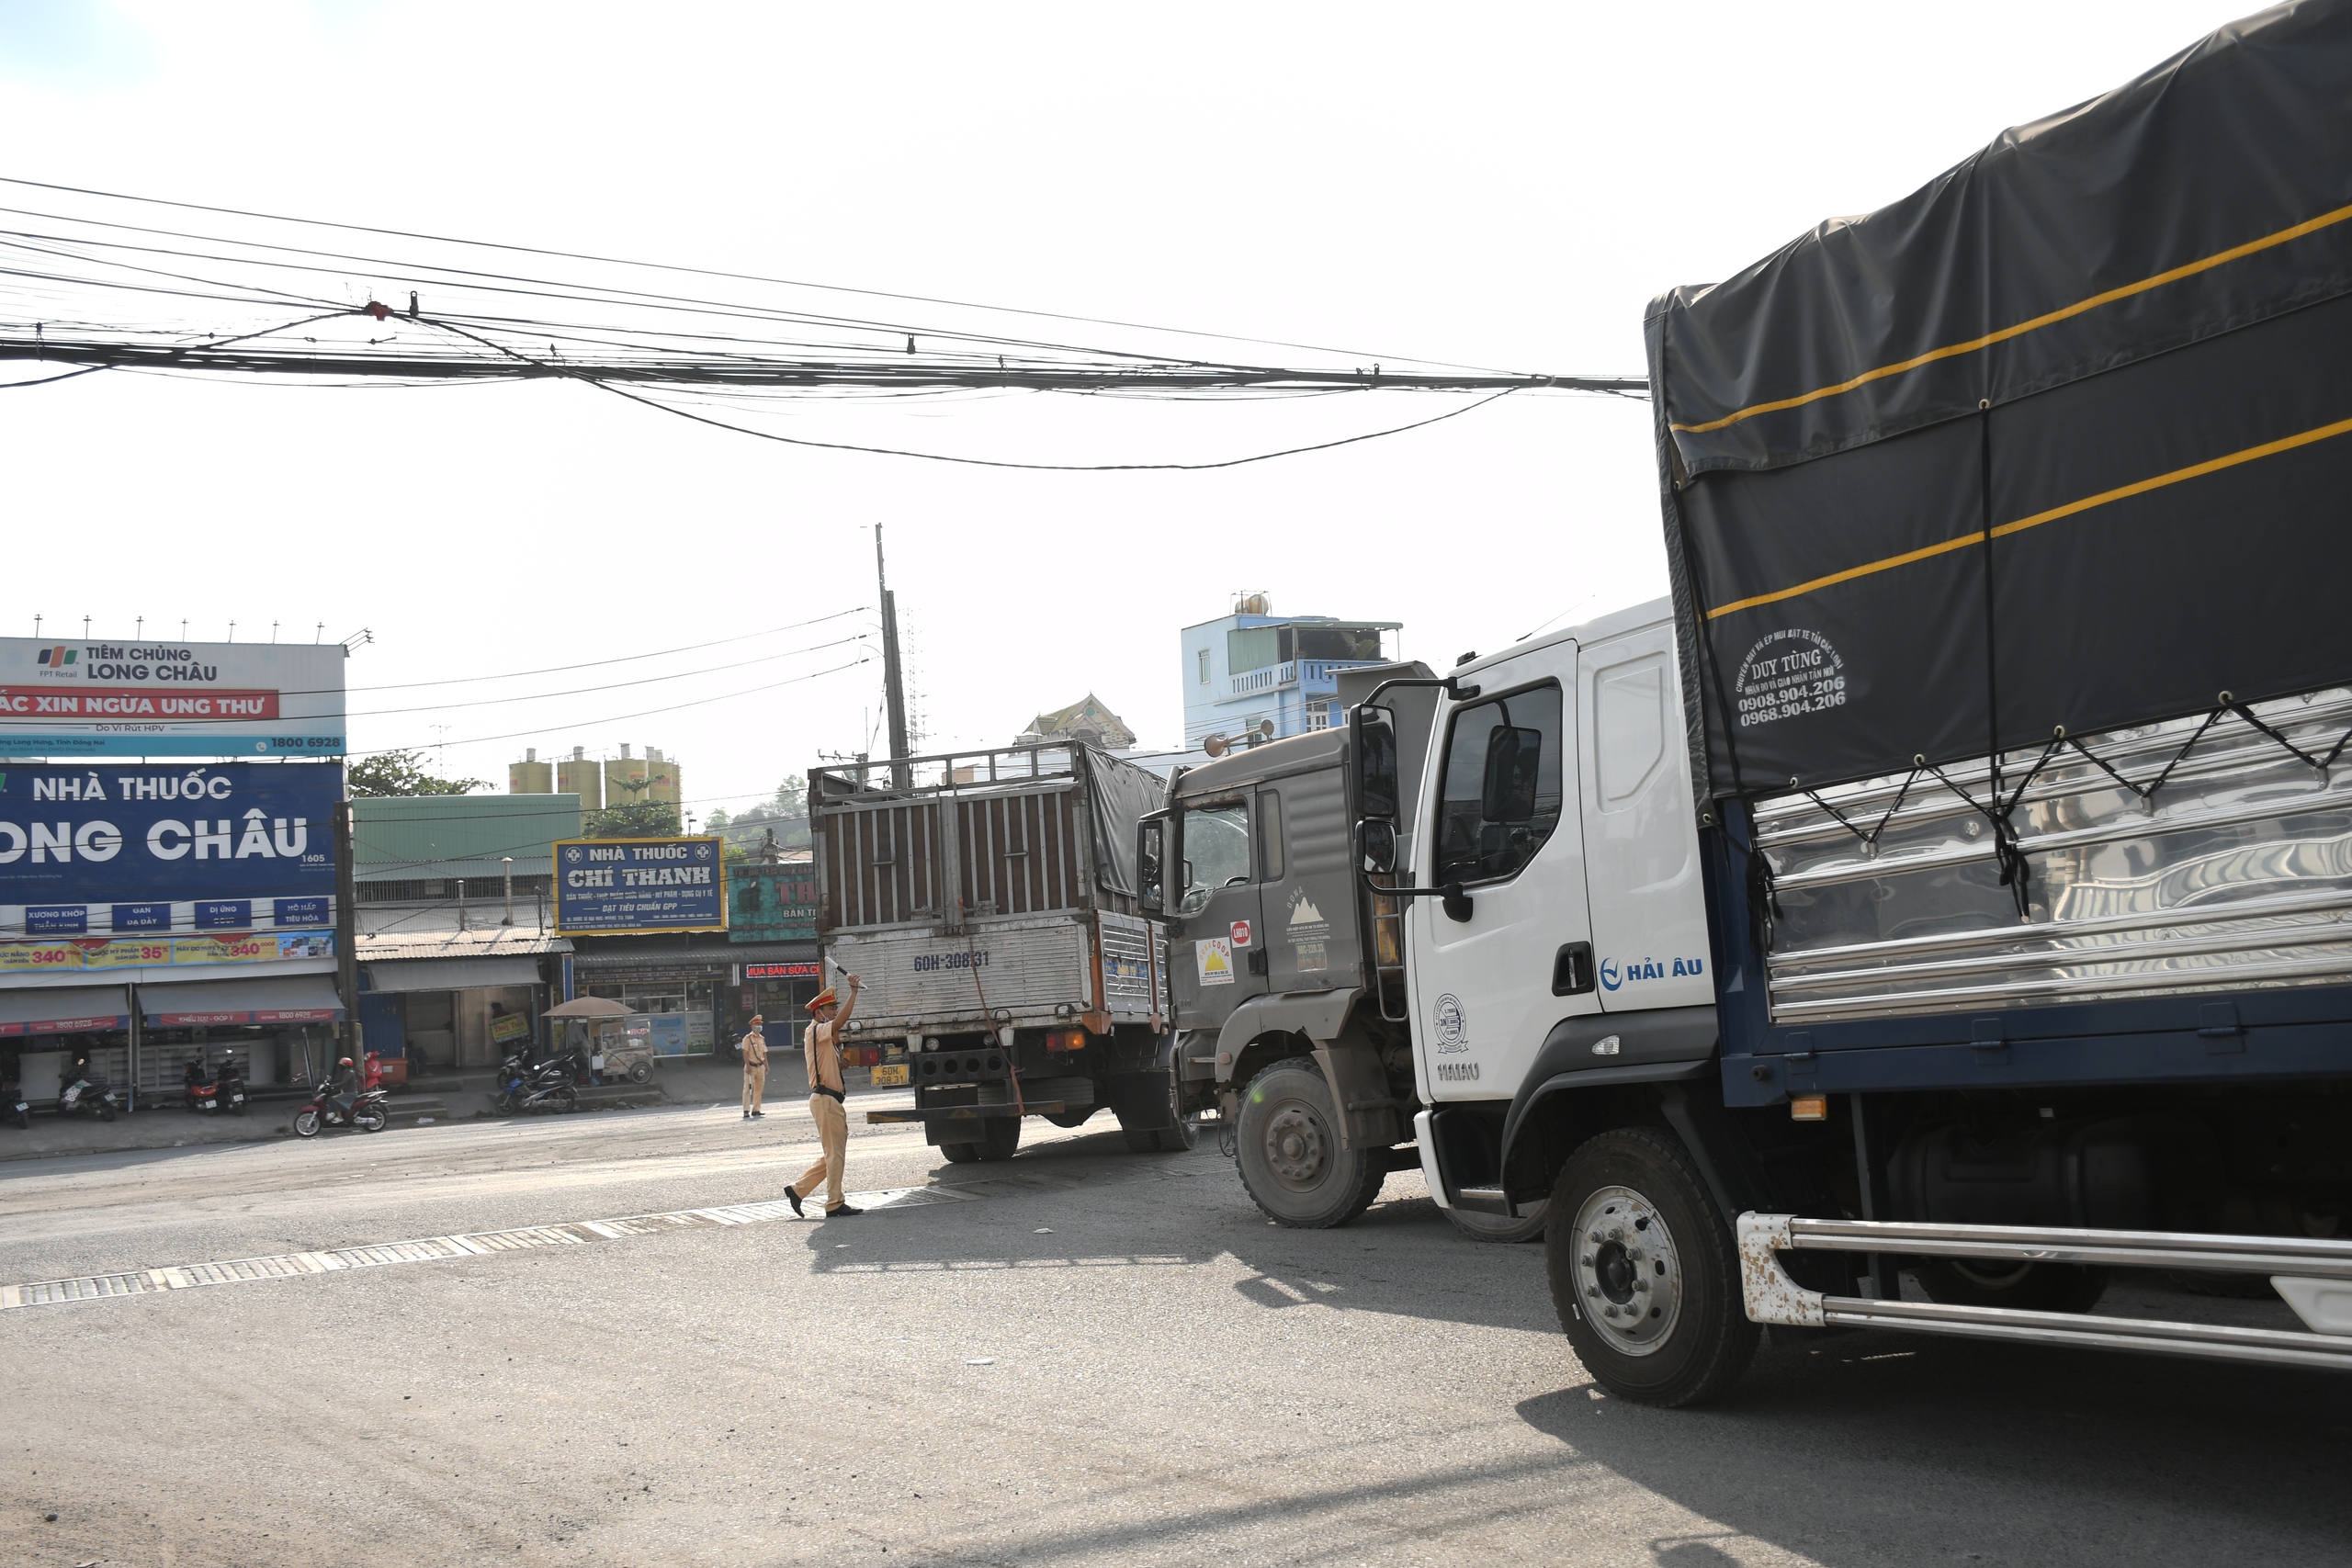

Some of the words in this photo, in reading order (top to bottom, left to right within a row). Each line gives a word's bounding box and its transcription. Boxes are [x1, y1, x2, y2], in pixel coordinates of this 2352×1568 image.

[1754, 638, 1764, 651] VÀ
[1801, 629, 1810, 640] XE
[1811, 631, 1821, 645] TẢI
[1820, 638, 1832, 654] CÁC
[86, 644, 124, 660] TIÊM
[130, 645, 192, 661] CHỦNG
[87, 663, 149, 681] LONG
[154, 661, 218, 681] CHÂU
[1751, 659, 1778, 680] DUY
[1781, 649, 1822, 672] TÙNG
[55, 670, 77, 678] Retail
[1769, 678, 1777, 690] VÀ
[1792, 671, 1808, 685] NHẬN
[1809, 668, 1822, 681] TẬN
[1738, 676, 1846, 713] 0908.904.206
[36, 696, 78, 712] XIN
[85, 694, 155, 714] NGỪA
[162, 698, 210, 714] UNG
[217, 696, 265, 715] THƯ
[1740, 692, 1846, 727] 0968.904.206
[96, 724, 109, 732] Do
[112, 724, 122, 732] Vi
[124, 723, 141, 732] Rút
[143, 724, 165, 732] HPV
[271, 738, 303, 748] 1800
[307, 738, 341, 748] 6928
[33, 772, 107, 801] NHÀ
[119, 768, 232, 800] THUỐC
[146, 807, 308, 861] CHÂU
[302, 854, 325, 863] 1605
[589, 845, 626, 862] NHÀ
[632, 843, 688, 861] THUỐC
[567, 865, 614, 888] CHÍ
[622, 866, 711, 886] THANH
[28, 911, 60, 919] XƯƠNG
[62, 909, 85, 918] KHỚP
[209, 906, 219, 915] DỊ
[602, 904, 616, 914] ĐẠT
[619, 903, 635, 912] TIÊU
[637, 900, 662, 911] CHUẨN
[662, 902, 677, 910] GPP
[302, 913, 320, 921] HÓA
[768, 964, 786, 976] BÁN
[1627, 956, 1664, 981] HẢI
[1672, 957, 1702, 976] ÂU
[74, 1020, 93, 1028] 6928
[178, 1014, 197, 1023] KHIẾU
[882, 1066, 898, 1076] 60H
[1437, 1062, 1479, 1081] HAIAU
